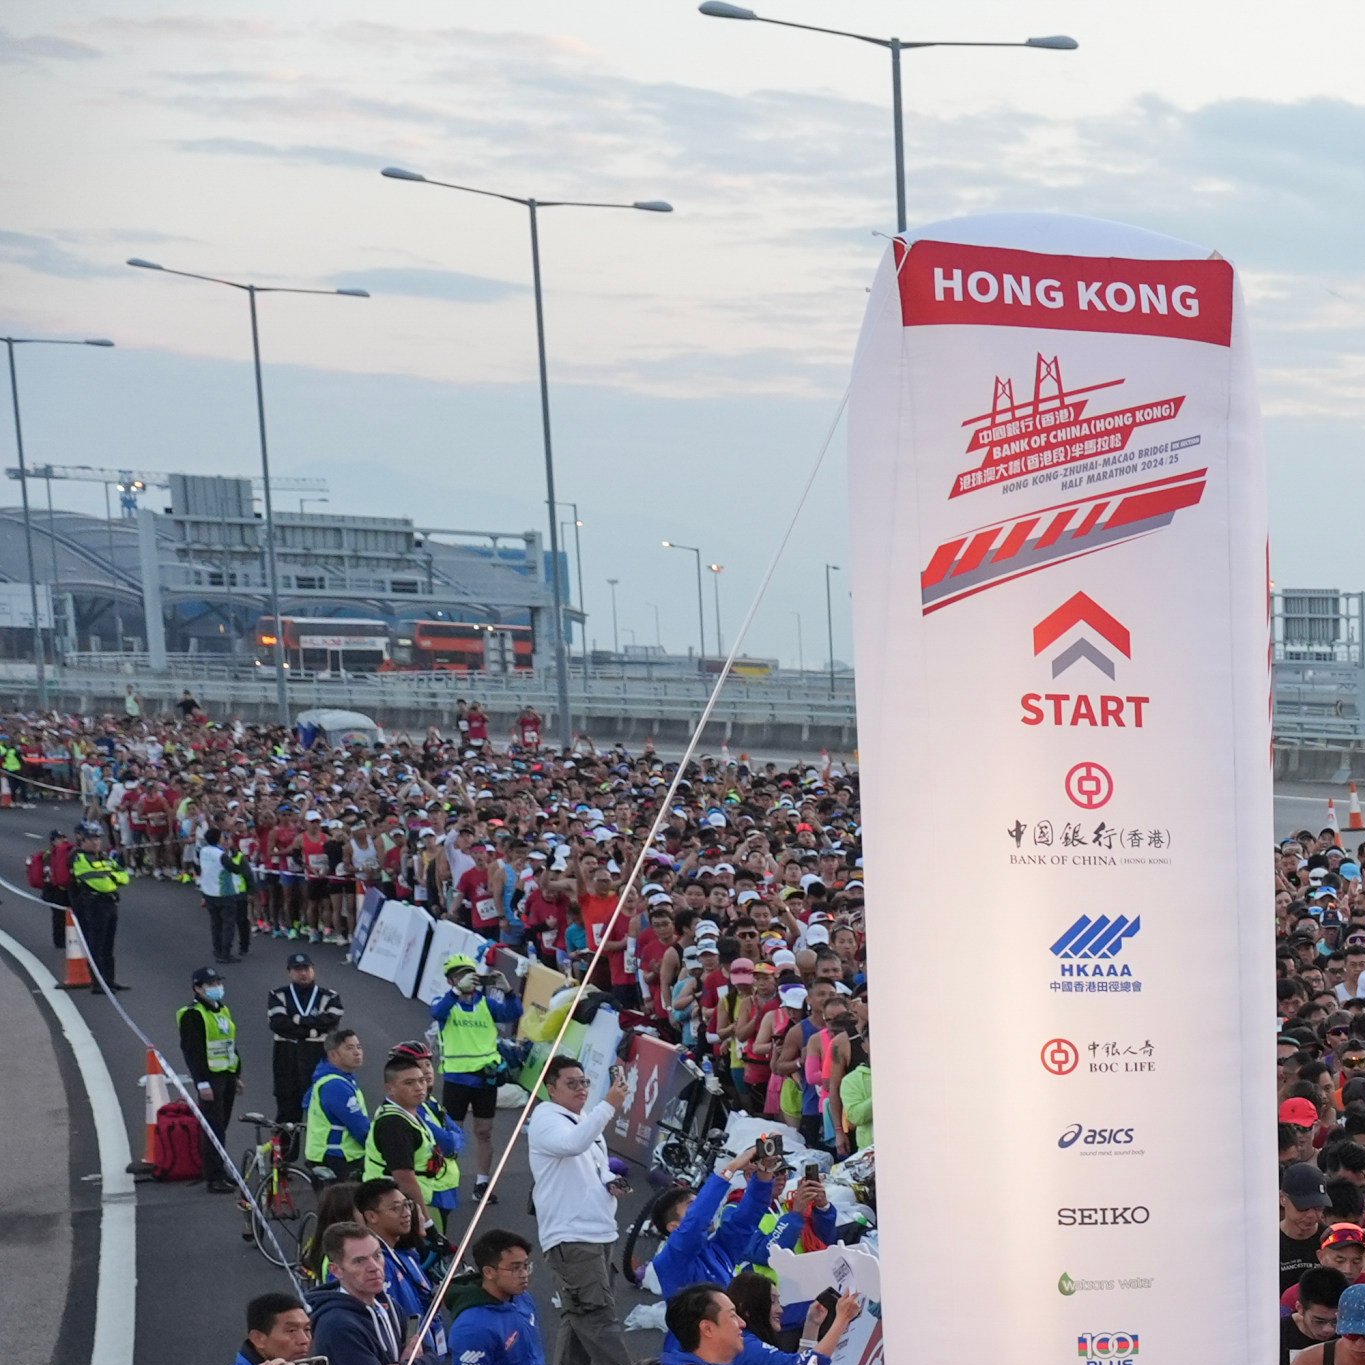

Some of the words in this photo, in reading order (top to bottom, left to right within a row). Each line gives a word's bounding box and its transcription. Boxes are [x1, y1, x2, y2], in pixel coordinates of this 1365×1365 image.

[933, 267, 1064, 309] HONG
[1077, 280, 1200, 318] KONG
[992, 438, 1030, 461] BANK
[1030, 436, 1048, 449] OF
[1049, 425, 1090, 445] CHINA
[1091, 412, 1133, 436] (HONG
[1135, 401, 1176, 422] KONG)
[1002, 478, 1029, 495] HONG
[1031, 452, 1135, 486] KONG-ZHUHAI-MACAO
[1137, 442, 1170, 459] BRIDGE
[1061, 477, 1084, 491] HALF
[1086, 465, 1138, 486] MARATHON
[1020, 693, 1149, 728] START
[1009, 854, 1047, 866] BANK
[1050, 854, 1068, 866] OF
[1072, 854, 1117, 867] CHINA
[1060, 963, 1132, 978] HKAAA
[1049, 980, 1142, 993] 中國香港田徑總會
[1089, 1062, 1119, 1073] BOC
[1125, 1061, 1156, 1072] LIFE
[1083, 1127, 1134, 1145] asics
[1057, 1206, 1151, 1226] SEIKO
